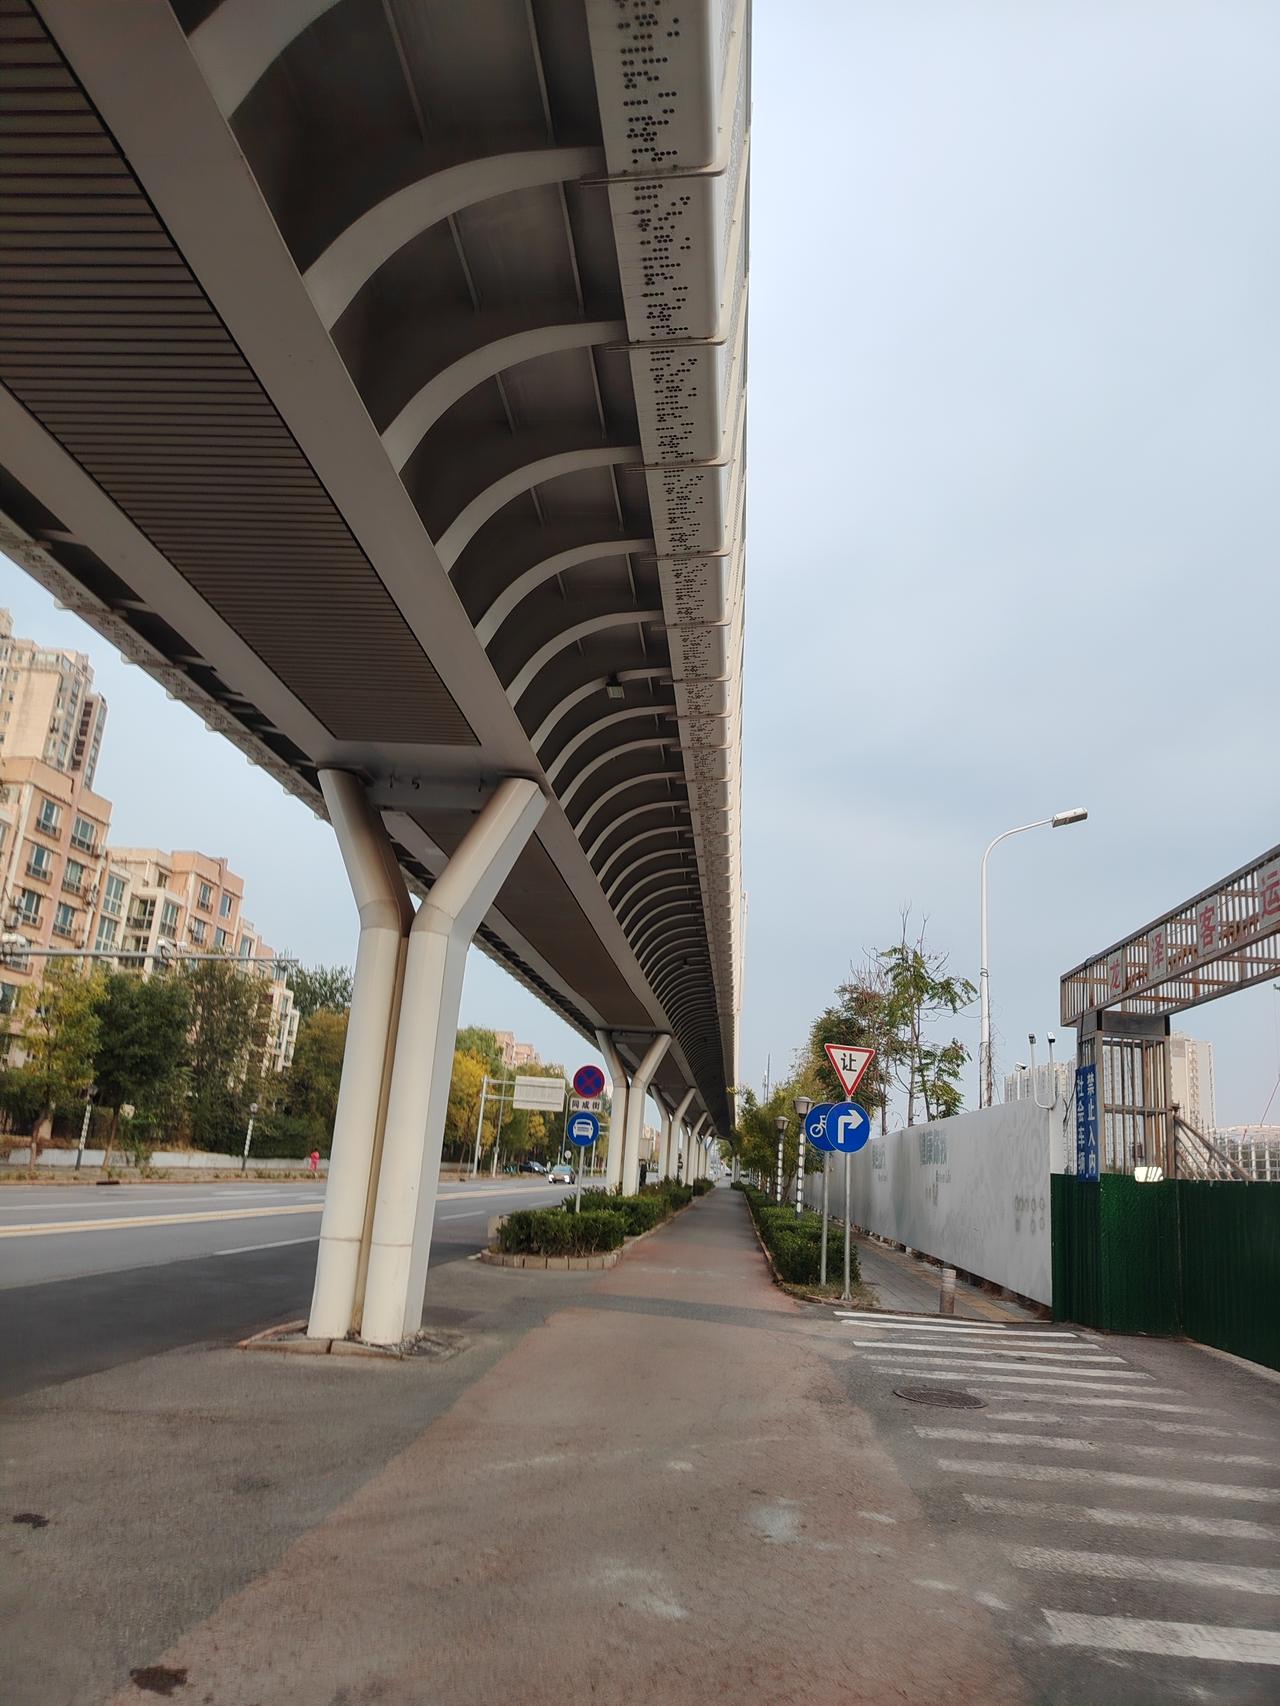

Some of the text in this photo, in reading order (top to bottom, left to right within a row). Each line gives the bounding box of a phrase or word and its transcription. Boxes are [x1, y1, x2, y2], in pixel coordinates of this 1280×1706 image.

[1110, 870, 1280, 990] 龙泽客运
[840, 1052, 857, 1072] 让
[1077, 1075, 1086, 1175] 社会车辆
[1086, 1071, 1096, 1175] 禁止入内
